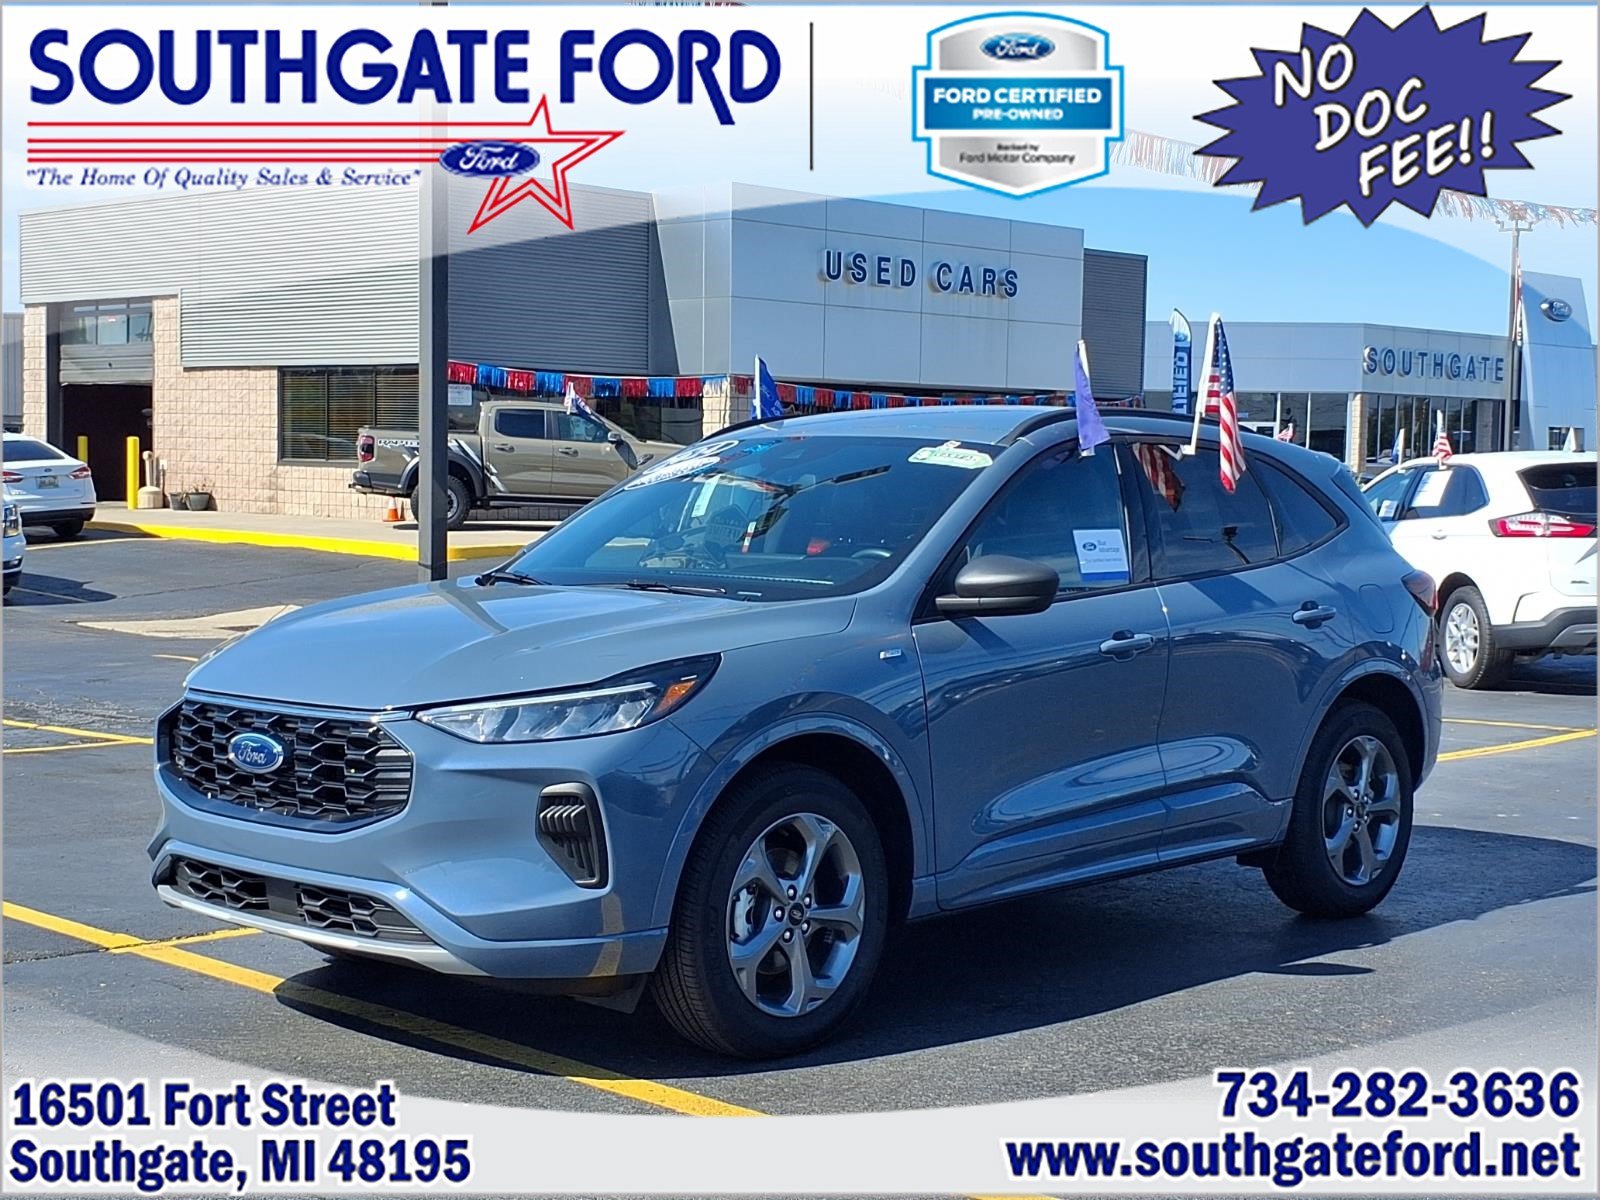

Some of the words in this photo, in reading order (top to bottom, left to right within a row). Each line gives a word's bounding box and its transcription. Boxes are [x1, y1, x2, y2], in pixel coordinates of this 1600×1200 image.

[825, 249, 916, 288] USED
[935, 261, 1018, 298] CARS
[1365, 346, 1505, 382] SOUTHGATE
